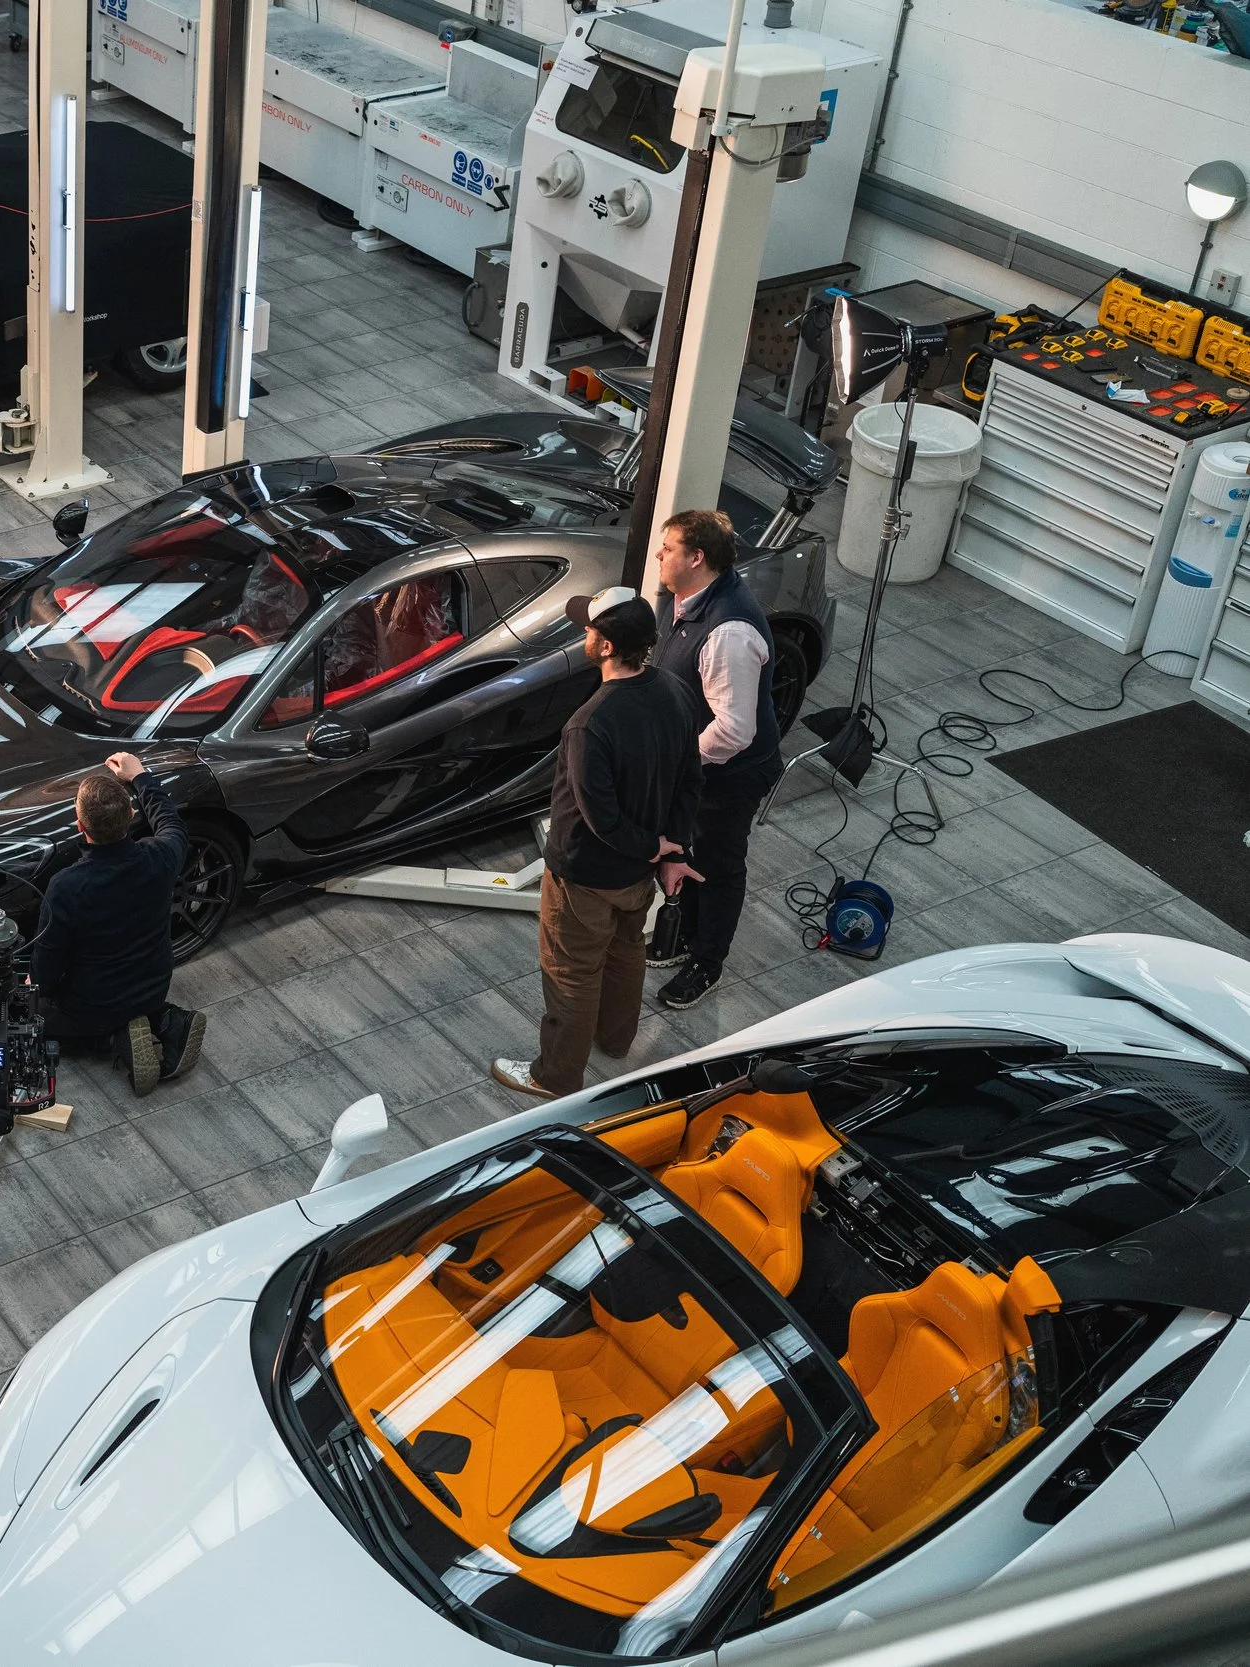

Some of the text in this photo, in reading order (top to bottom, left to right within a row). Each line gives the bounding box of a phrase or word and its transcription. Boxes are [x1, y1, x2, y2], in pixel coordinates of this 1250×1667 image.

[261, 102, 312, 133] RBON ONLY
[401, 174, 444, 203] CARBON
[445, 196, 475, 217] ONLY
[514, 308, 526, 363] BARRACUDA
[38, 1101, 50, 1110] R2
